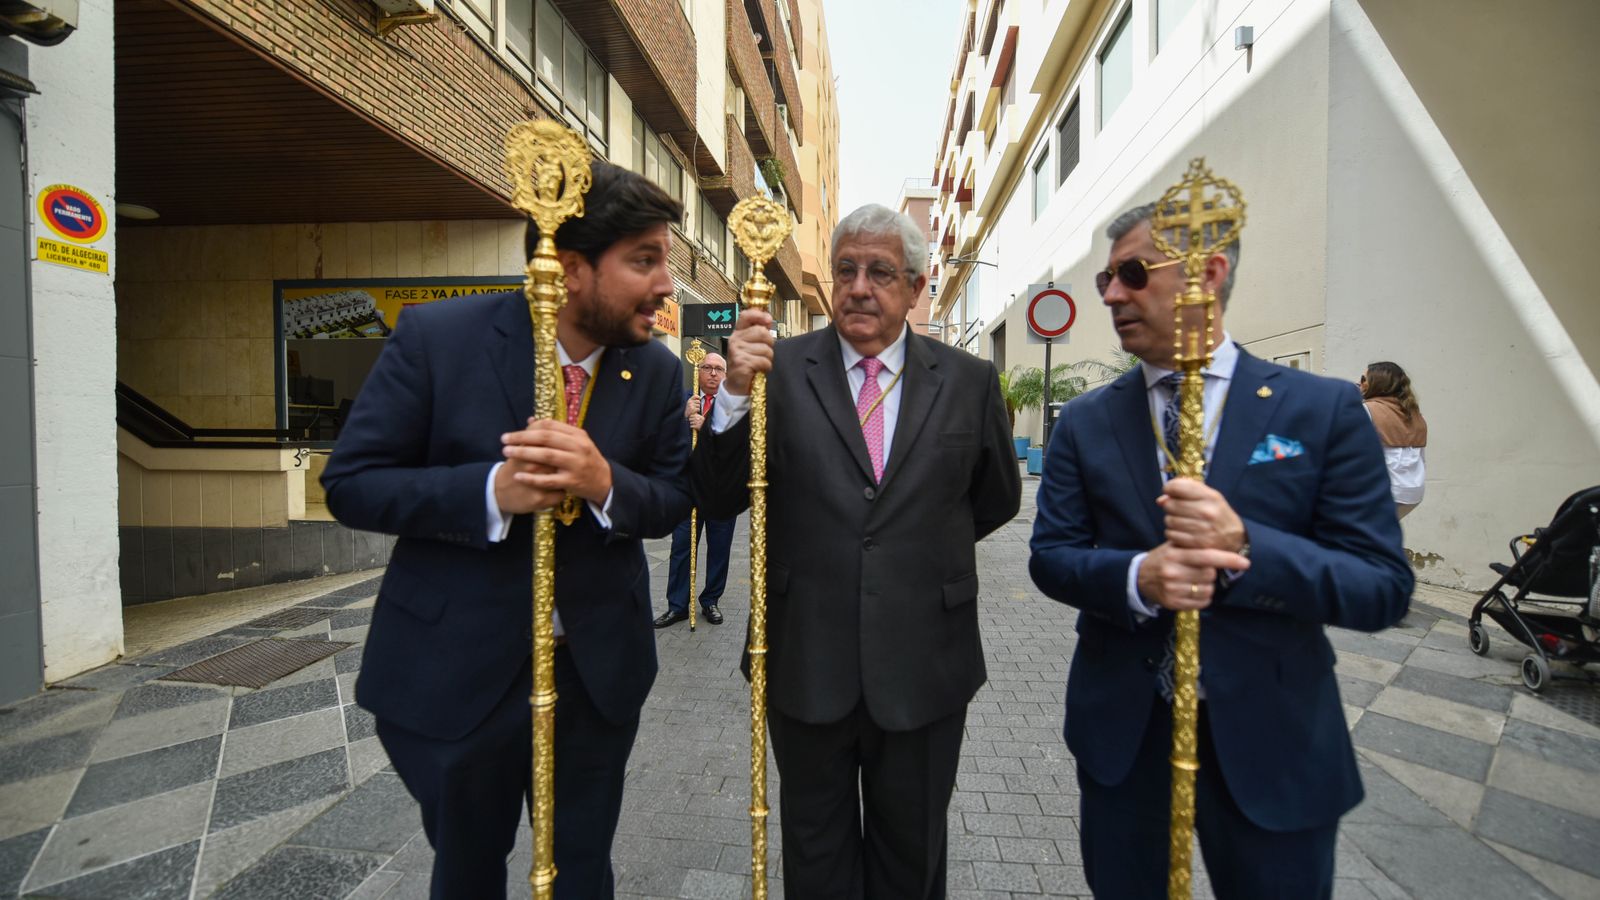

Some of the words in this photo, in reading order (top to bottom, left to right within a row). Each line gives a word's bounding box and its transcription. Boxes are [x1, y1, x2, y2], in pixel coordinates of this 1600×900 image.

[65, 204, 81, 213] VADO
[54, 207, 92, 222] PERMANENTE
[40, 241, 59, 252] AYTO.
[61, 246, 70, 255] DE
[72, 248, 106, 263] ALGECIRAS
[46, 253, 77, 264] LICENCIA
[385, 289, 418, 300] FASE
[421, 289, 429, 299] 2
[431, 289, 448, 299] YA
[450, 289, 459, 298] A
